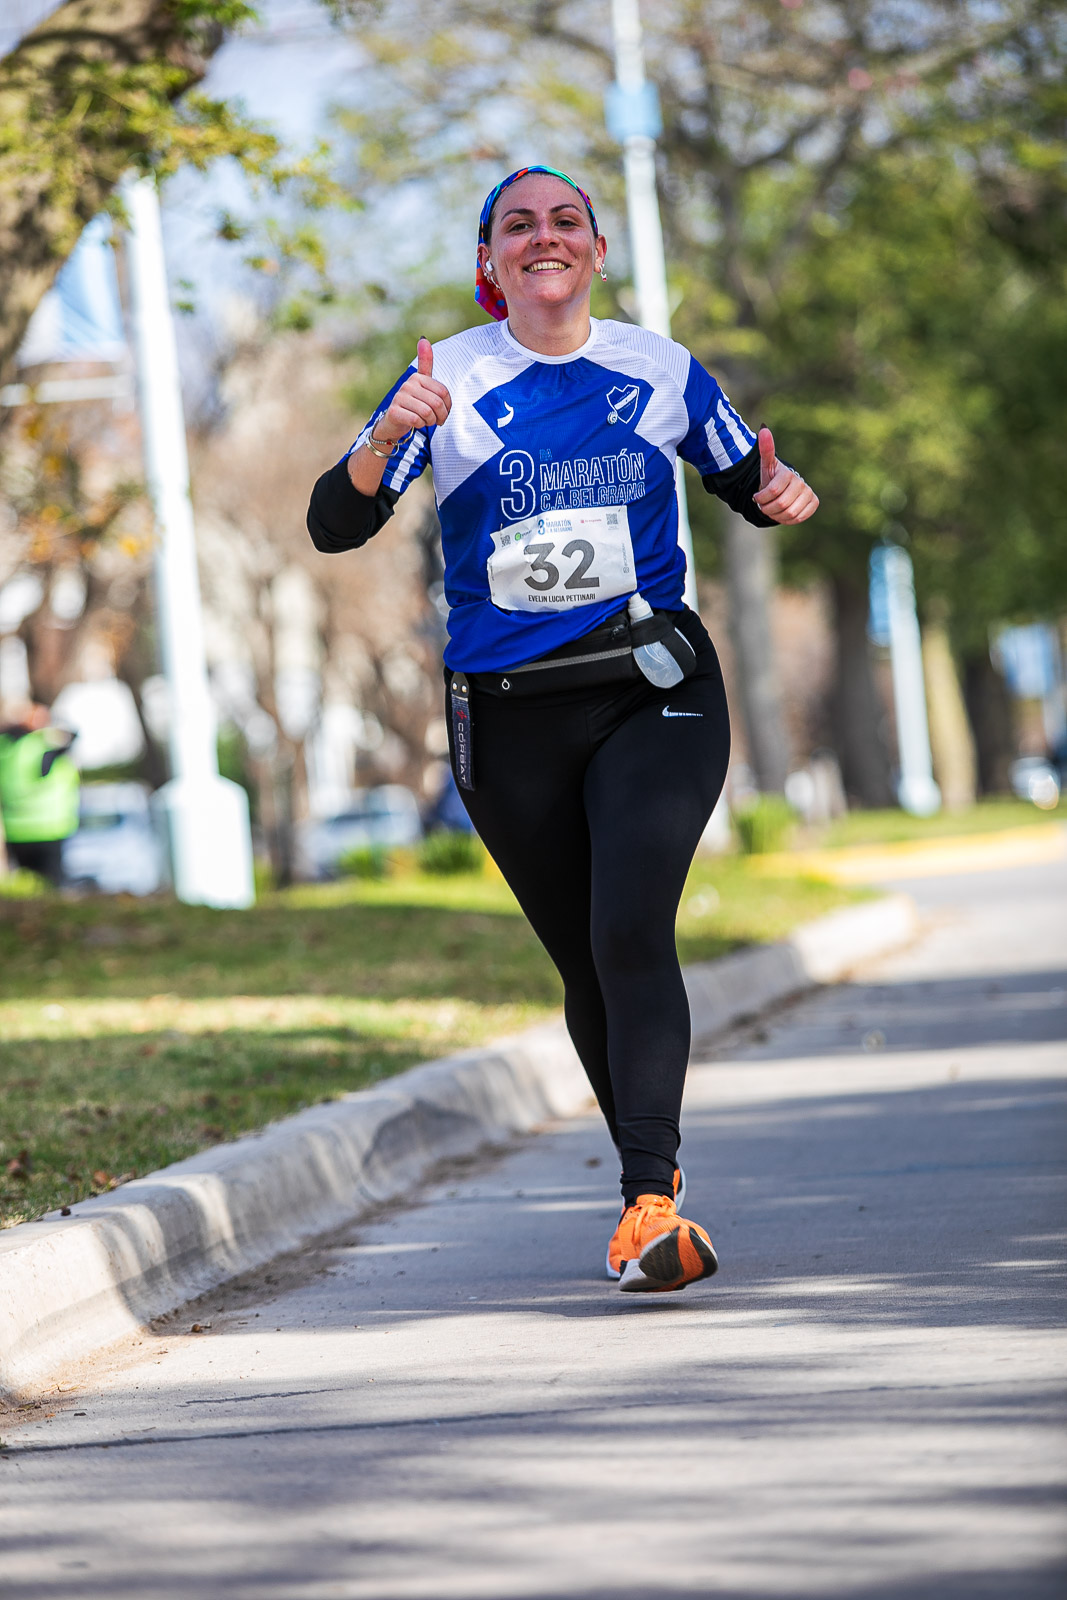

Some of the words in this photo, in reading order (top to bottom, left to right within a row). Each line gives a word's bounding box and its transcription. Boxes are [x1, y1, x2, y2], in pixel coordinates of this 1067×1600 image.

[500, 450, 536, 521] 3
[540, 448, 646, 492] MARATÓN
[523, 539, 600, 591] 32
[528, 594, 548, 603] EVELIN
[548, 595, 566, 603] LUCIA
[565, 593, 596, 602] PETTINARI
